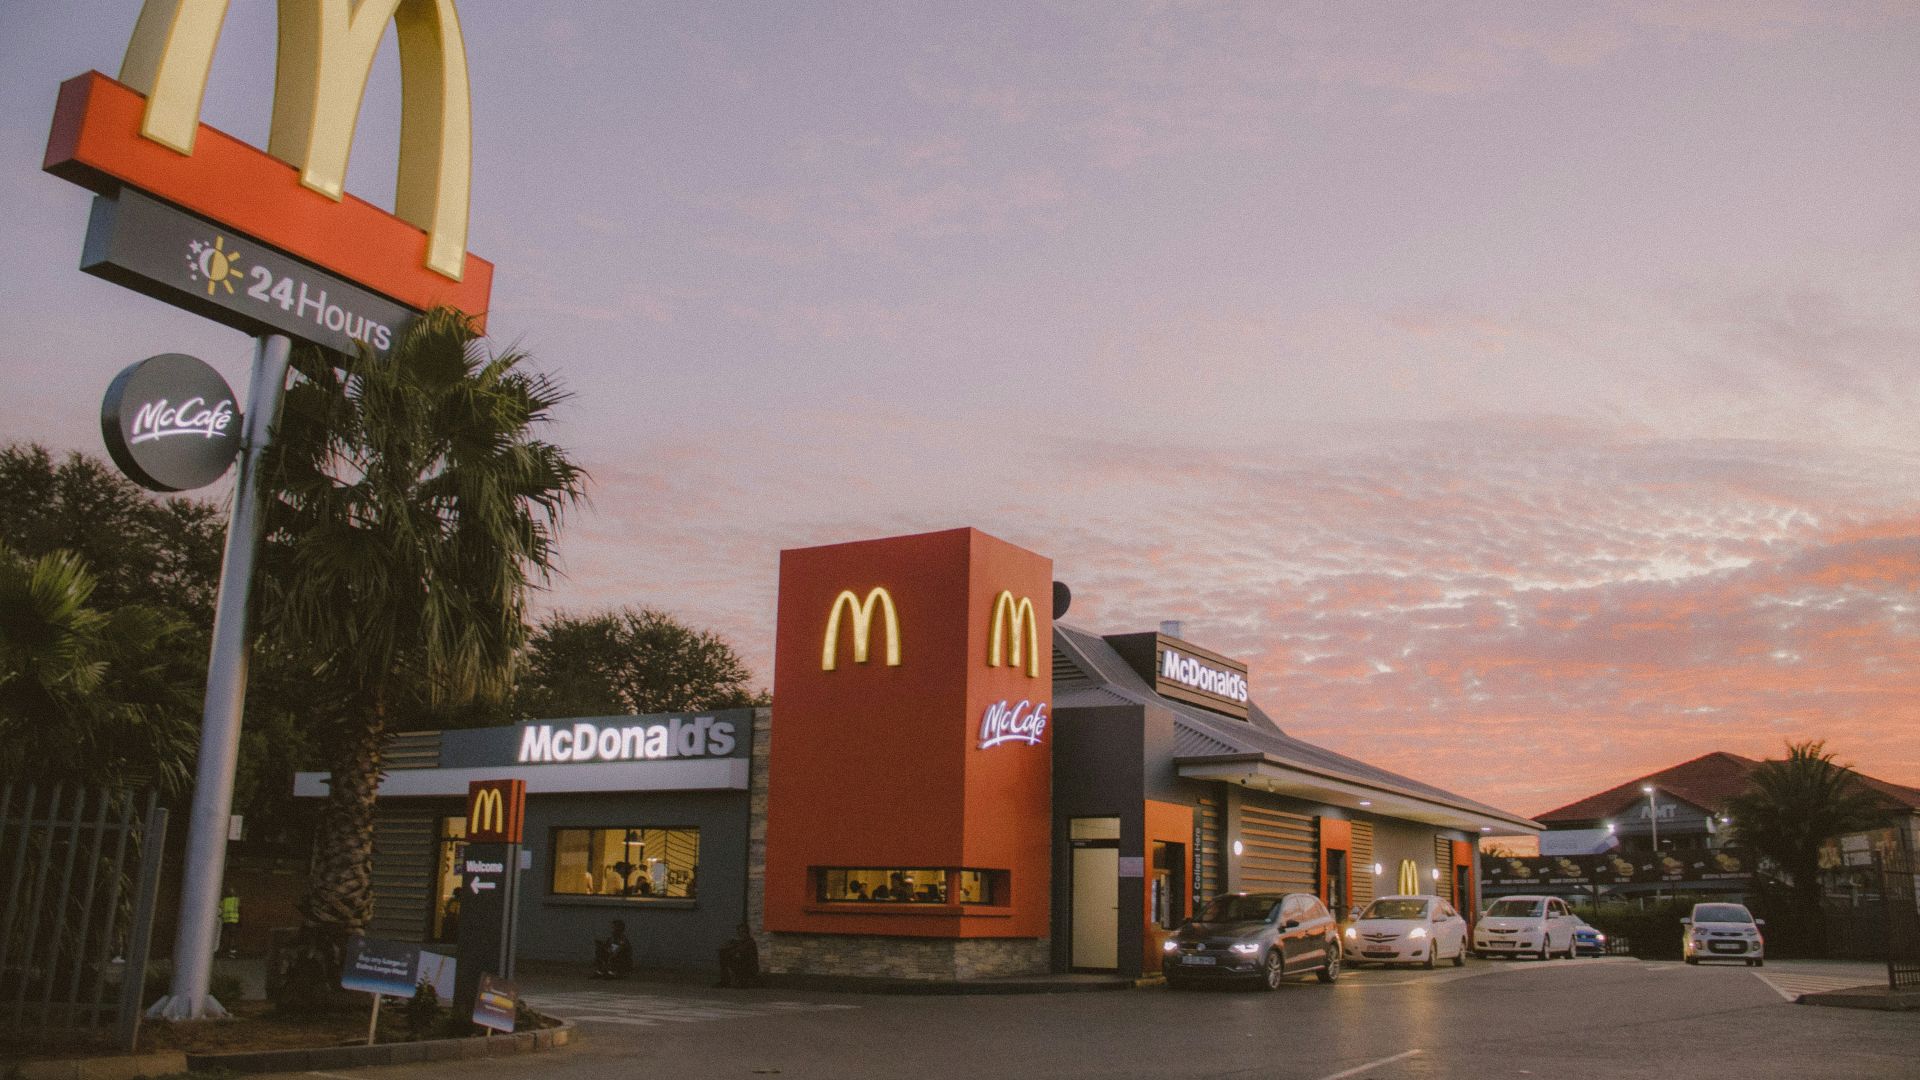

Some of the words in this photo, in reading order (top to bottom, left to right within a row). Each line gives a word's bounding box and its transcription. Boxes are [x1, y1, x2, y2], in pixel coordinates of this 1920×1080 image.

[131, 397, 233, 443] McCafé
[1162, 649, 1248, 702] McDonald's
[518, 716, 736, 763] McDonald's
[979, 699, 1047, 747] McCafé
[466, 860, 503, 872] Welcome
